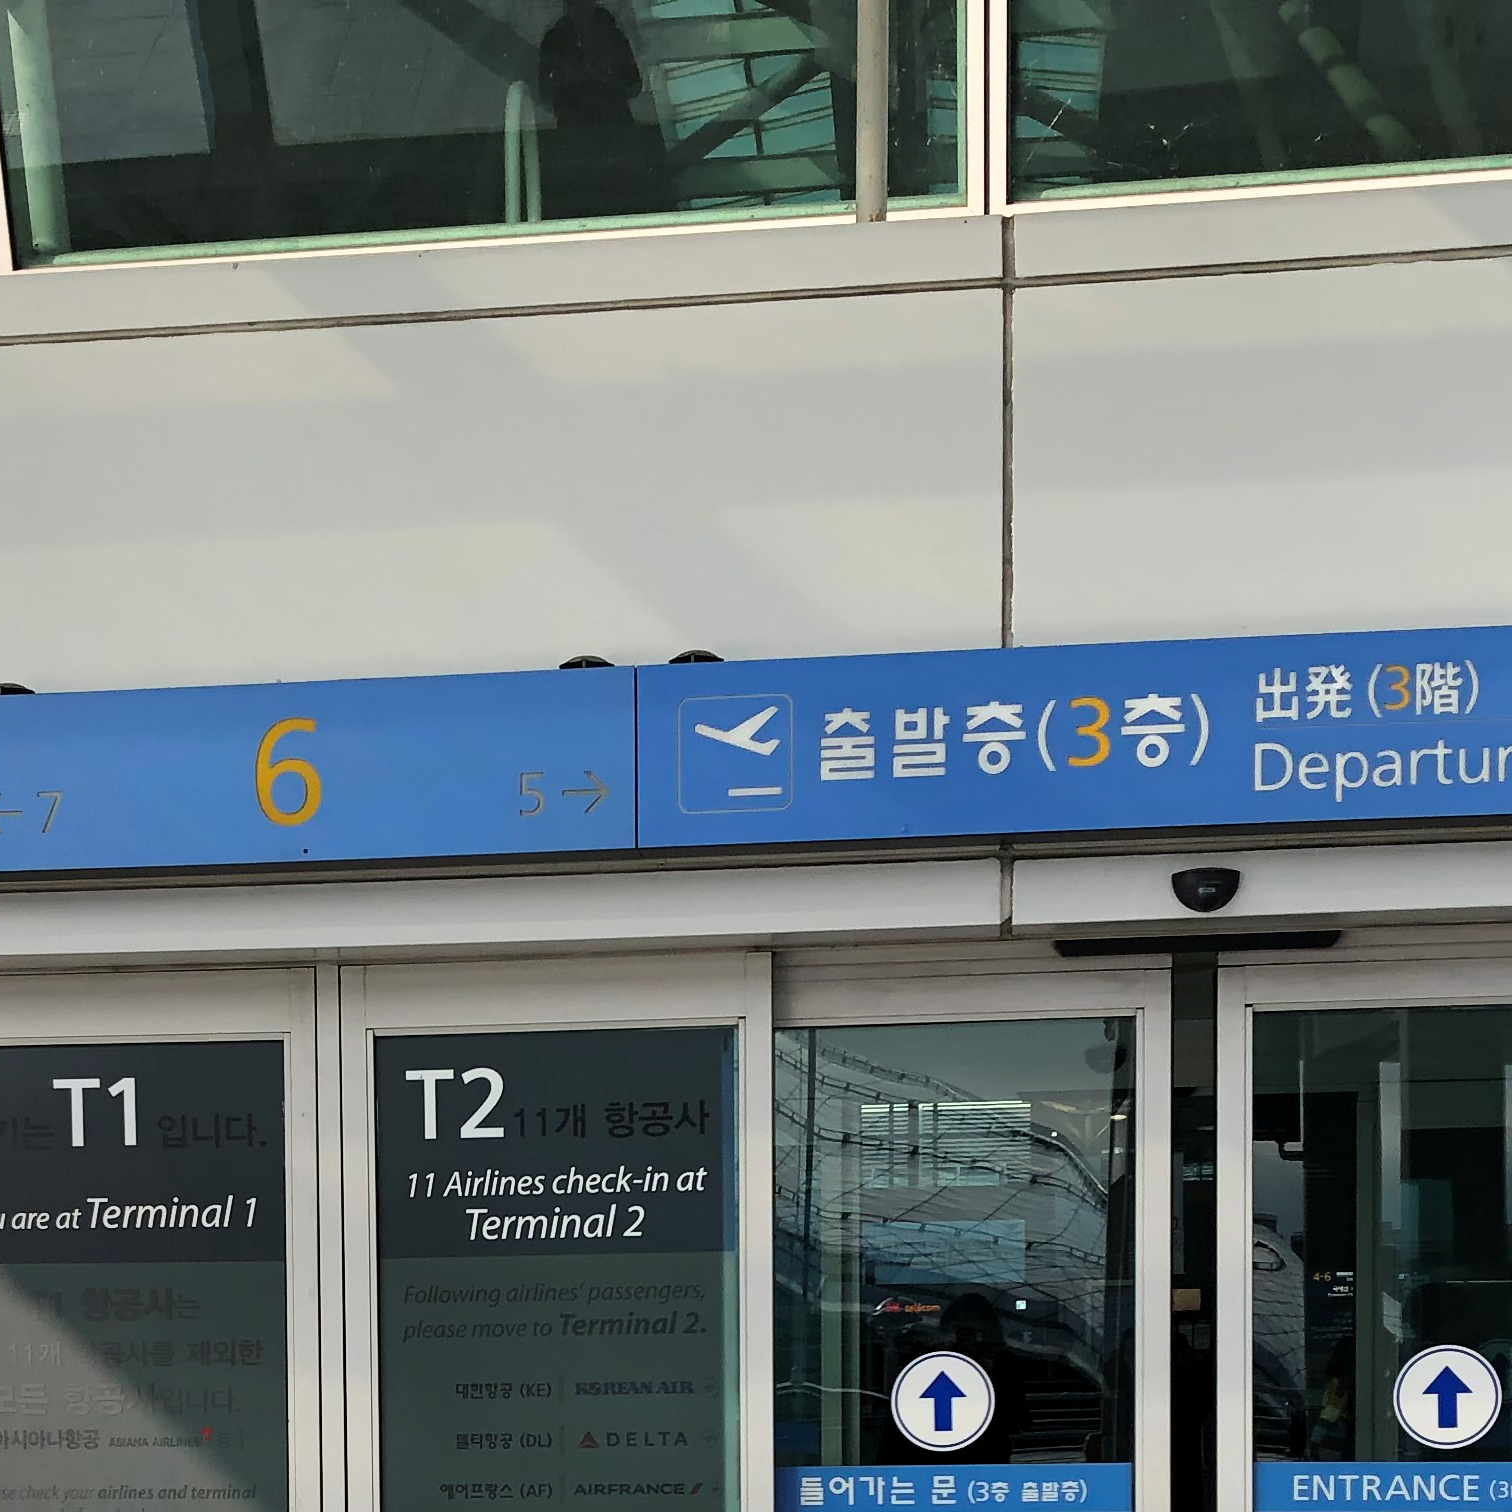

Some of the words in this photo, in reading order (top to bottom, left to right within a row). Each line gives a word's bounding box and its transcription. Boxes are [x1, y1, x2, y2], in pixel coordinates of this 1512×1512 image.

[255, 716, 323, 826] 6
[518, 772, 546, 816] 5
[36, 790, 63, 833] 7
[52, 1077, 138, 1147] T1
[405, 1067, 505, 1141] T2
[513, 1103, 587, 1139] 11개
[604, 1099, 710, 1139] 항공사
[408, 1172, 435, 1198] 11
[442, 1169, 546, 1198] Airlines
[552, 1165, 670, 1195] check-in
[676, 1167, 708, 1191] at
[11, 1211, 49, 1231] are
[55, 1208, 82, 1230] at
[87, 1195, 233, 1230] Terminal
[245, 1197, 257, 1228] 1
[465, 1203, 617, 1241] Terminal
[623, 1205, 646, 1237] 2
[403, 1285, 501, 1307] Following
[403, 1320, 466, 1343] please
[471, 1322, 528, 1338] move
[532, 1320, 552, 1338] to
[559, 1312, 677, 1336] Terminal
[519, 1382, 552, 1400] (KE)
[519, 1432, 552, 1450] (DL)
[606, 1431, 688, 1447] DELTA
[18, 1485, 60, 1500] check
[62, 1487, 95, 1504] your
[97, 1484, 154, 1500] airlines
[158, 1484, 187, 1500] and
[191, 1484, 257, 1500] terminal
[519, 1482, 553, 1500] (AF)
[573, 1483, 685, 1496] AIRFRANCE
[799, 1476, 915, 1506] 들어가는
[931, 1475, 957, 1505] 문
[967, 1479, 1010, 1505] (3층
[1021, 1479, 1088, 1504] 출발층)
[1293, 1474, 1480, 1502] ENTRANCE
[1489, 1479, 1512, 1502] (3
